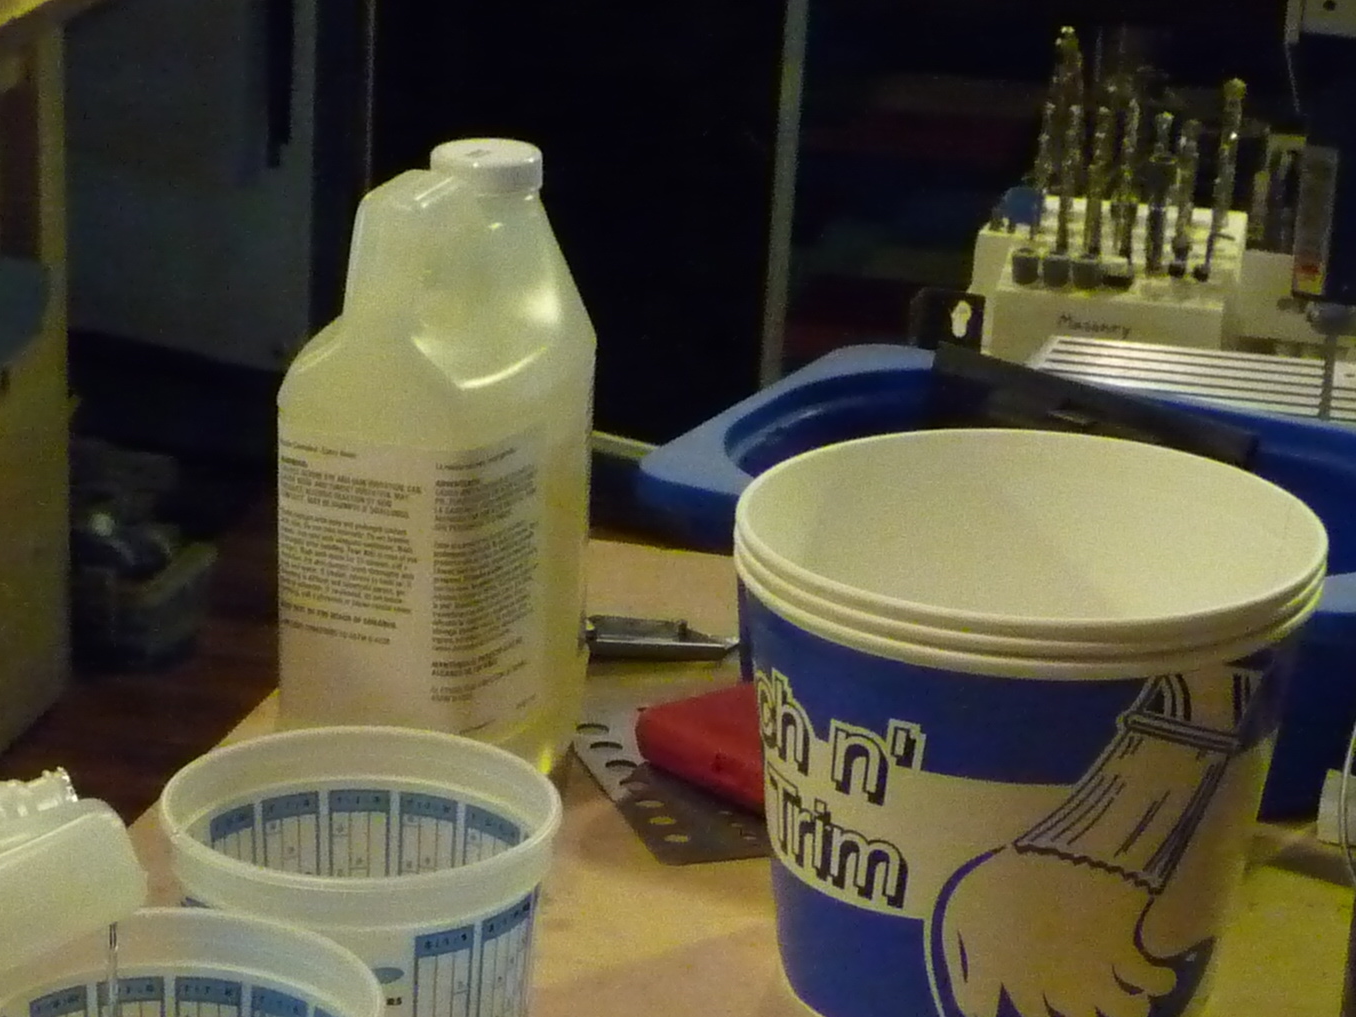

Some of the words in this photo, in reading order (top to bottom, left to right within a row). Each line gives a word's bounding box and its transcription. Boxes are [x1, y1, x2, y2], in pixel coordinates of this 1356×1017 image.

[1057, 313, 1131, 339] Masonry
[756, 669, 810, 777] ch
[766, 760, 909, 909] Trim
